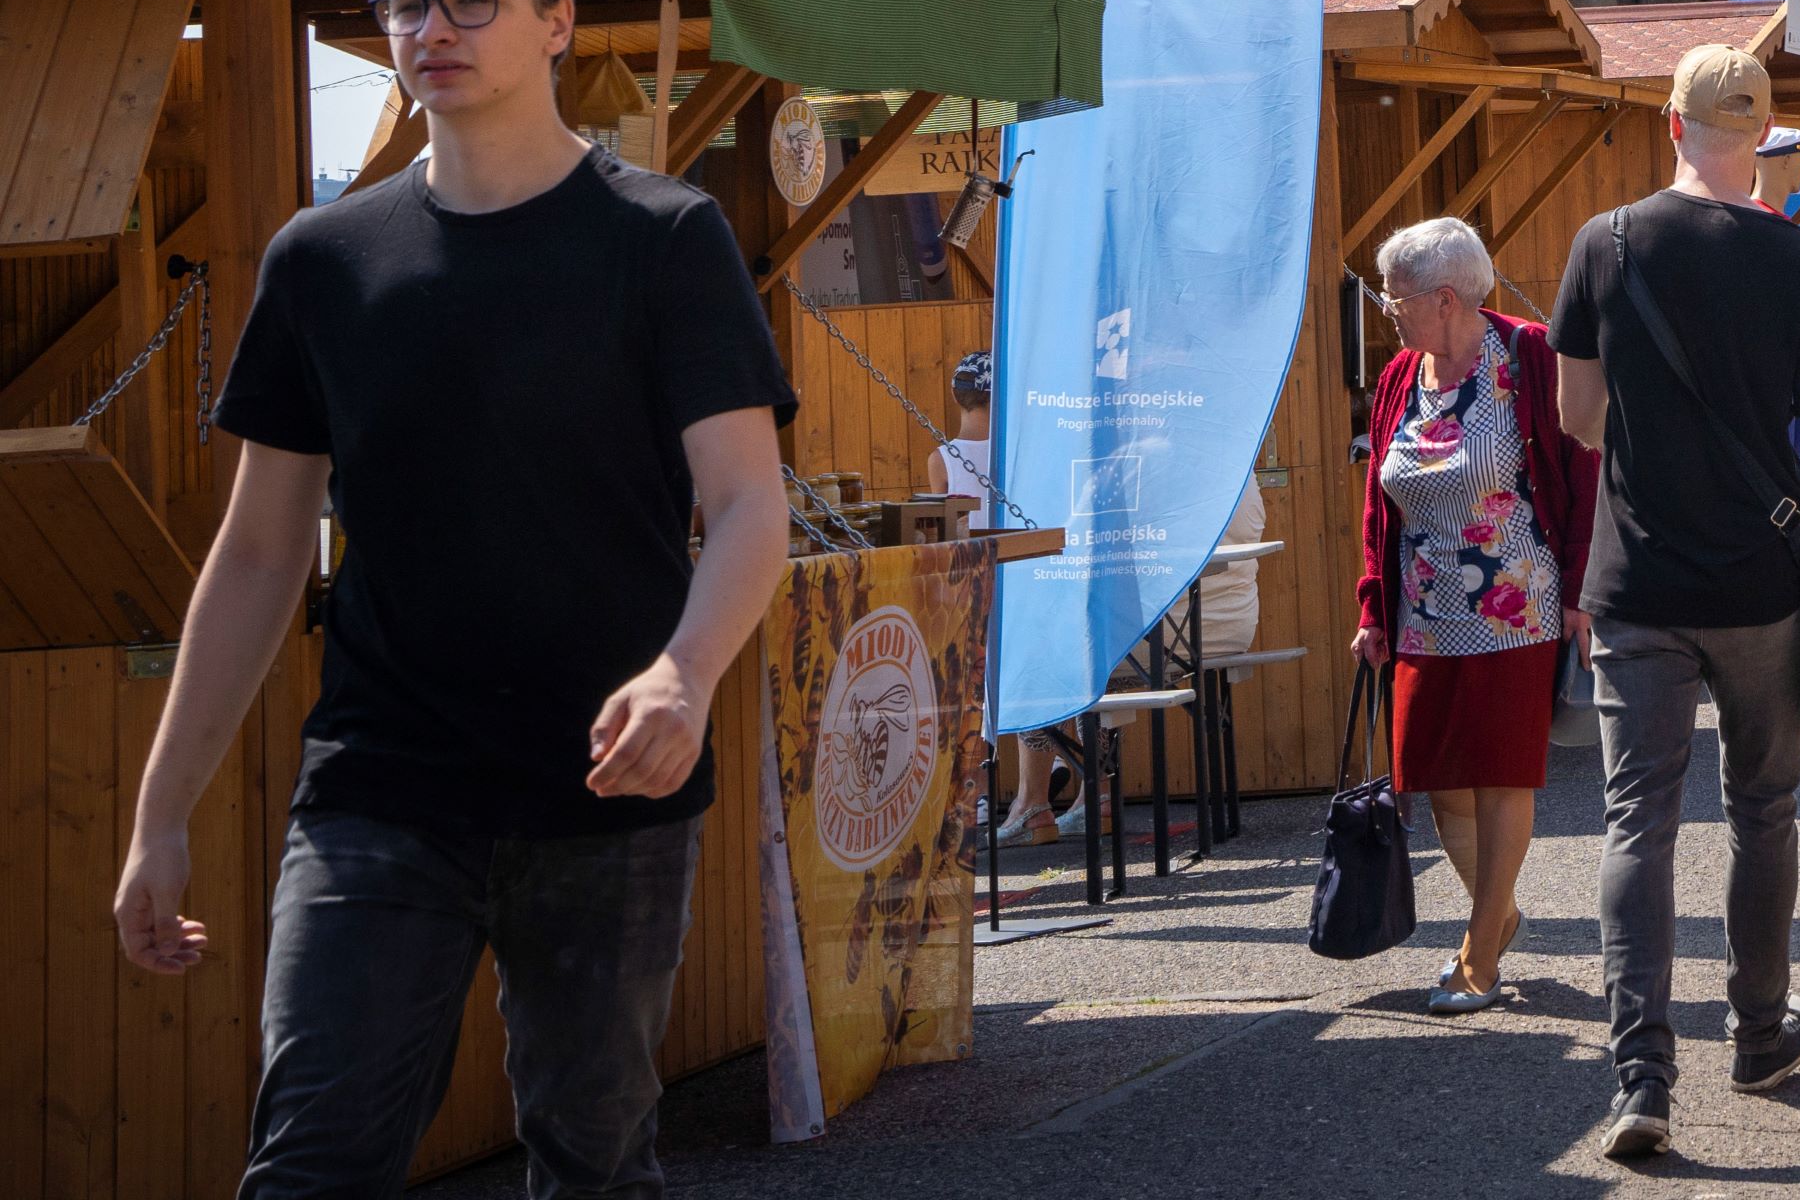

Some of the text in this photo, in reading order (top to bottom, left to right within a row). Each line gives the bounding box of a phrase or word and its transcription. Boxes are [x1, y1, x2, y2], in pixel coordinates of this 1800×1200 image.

[1026, 390, 1205, 410] Fundusze Europejskie
[1057, 414, 1166, 432] Program Regionalny
[1085, 523, 1167, 546] Europejska
[1107, 549, 1159, 561] Fundusze
[846, 623, 918, 680] MIODY
